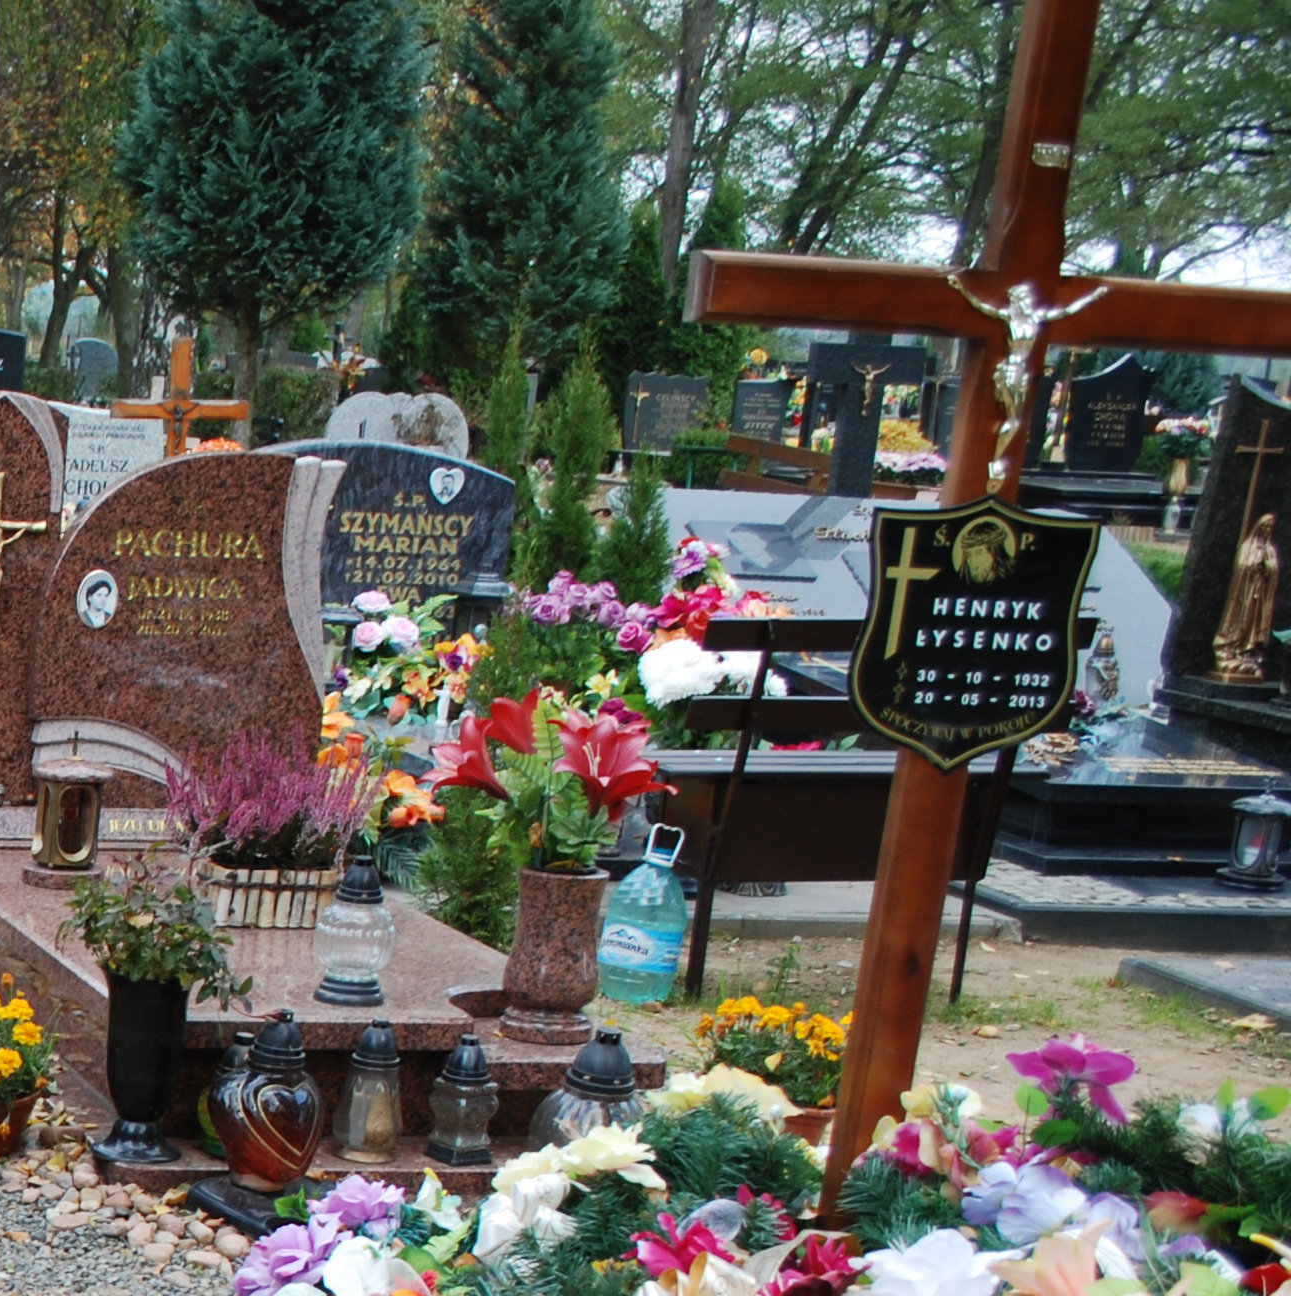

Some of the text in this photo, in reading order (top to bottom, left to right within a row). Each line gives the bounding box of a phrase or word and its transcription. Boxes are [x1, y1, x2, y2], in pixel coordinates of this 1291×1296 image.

[67, 458, 129, 473] ADEUSZ
[339, 508, 475, 537] SZYMAŃSCY
[114, 528, 264, 559] PACHURA
[354, 535, 459, 555] MARIAN
[126, 575, 243, 601] JADWIGA
[932, 597, 1044, 621] HENRYK
[915, 628, 1053, 652] ŁYSENKO
[916, 669, 937, 683] 30
[966, 671, 983, 684] 10
[1014, 673, 1050, 688] 1932
[914, 691, 935, 704] 20
[961, 693, 979, 706] 05
[1008, 695, 1046, 709] 2013
